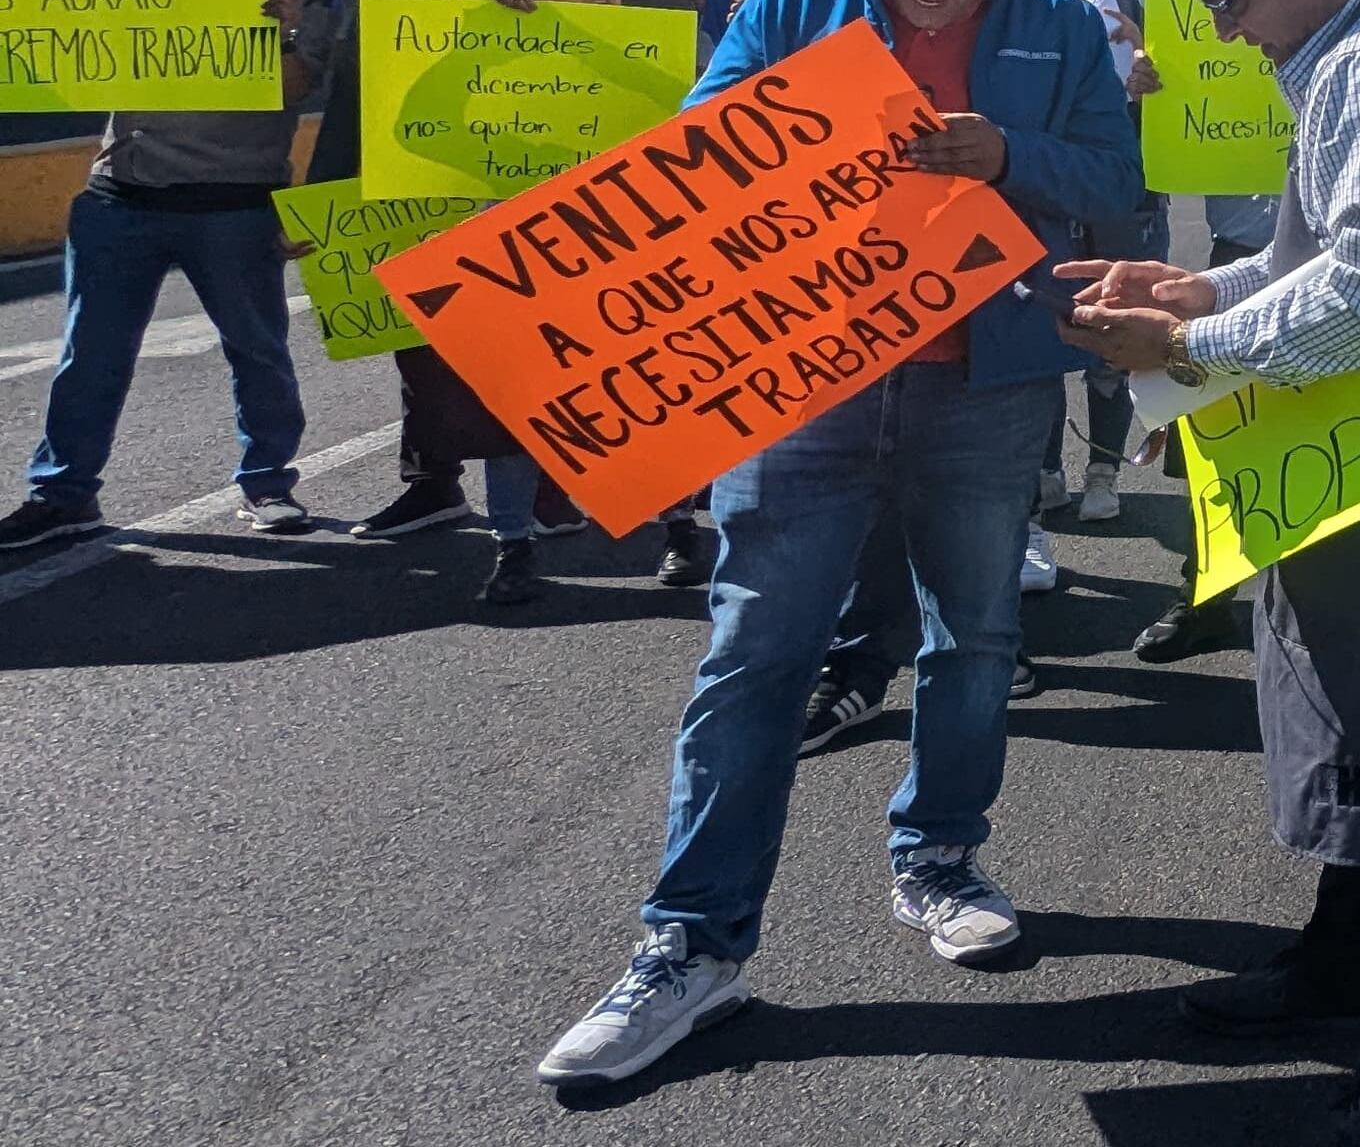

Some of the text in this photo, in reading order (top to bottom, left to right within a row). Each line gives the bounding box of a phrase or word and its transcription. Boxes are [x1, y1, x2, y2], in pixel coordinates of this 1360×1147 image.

[0, 25, 278, 84] REMOS TRABAJO!!!
[395, 14, 659, 61] Autoridades en
[466, 64, 604, 95] diciembre
[1199, 59, 1241, 80] nos
[404, 111, 600, 145] nos quitan el
[456, 74, 834, 299] VENIMOS
[533, 321, 595, 370] A
[595, 255, 715, 336] QUE
[709, 198, 819, 272] NOS
[526, 226, 910, 476] NECESITAMOS
[692, 269, 958, 439] TRABAJO
